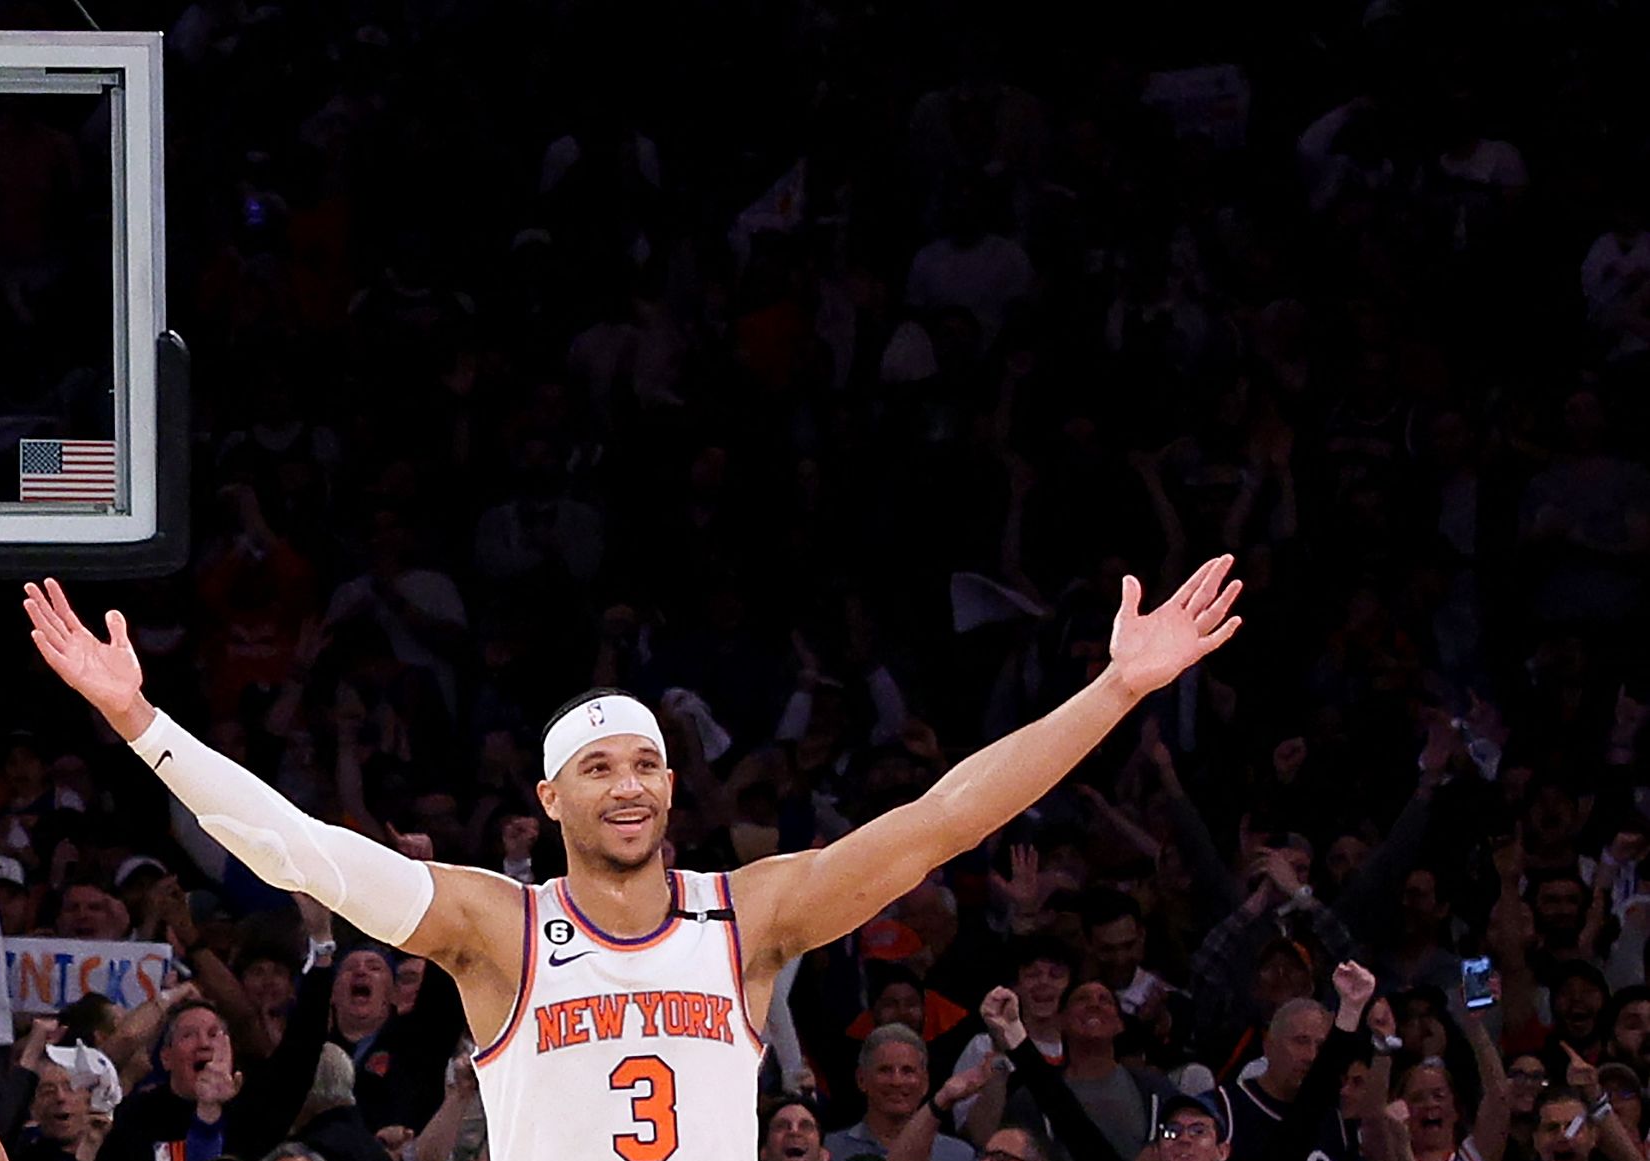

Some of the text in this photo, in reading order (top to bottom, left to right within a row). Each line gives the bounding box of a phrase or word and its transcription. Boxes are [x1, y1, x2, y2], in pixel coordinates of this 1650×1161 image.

[549, 921, 569, 943] 6
[5, 952, 168, 1009] NICKS!
[534, 990, 735, 1055] NEW YORK
